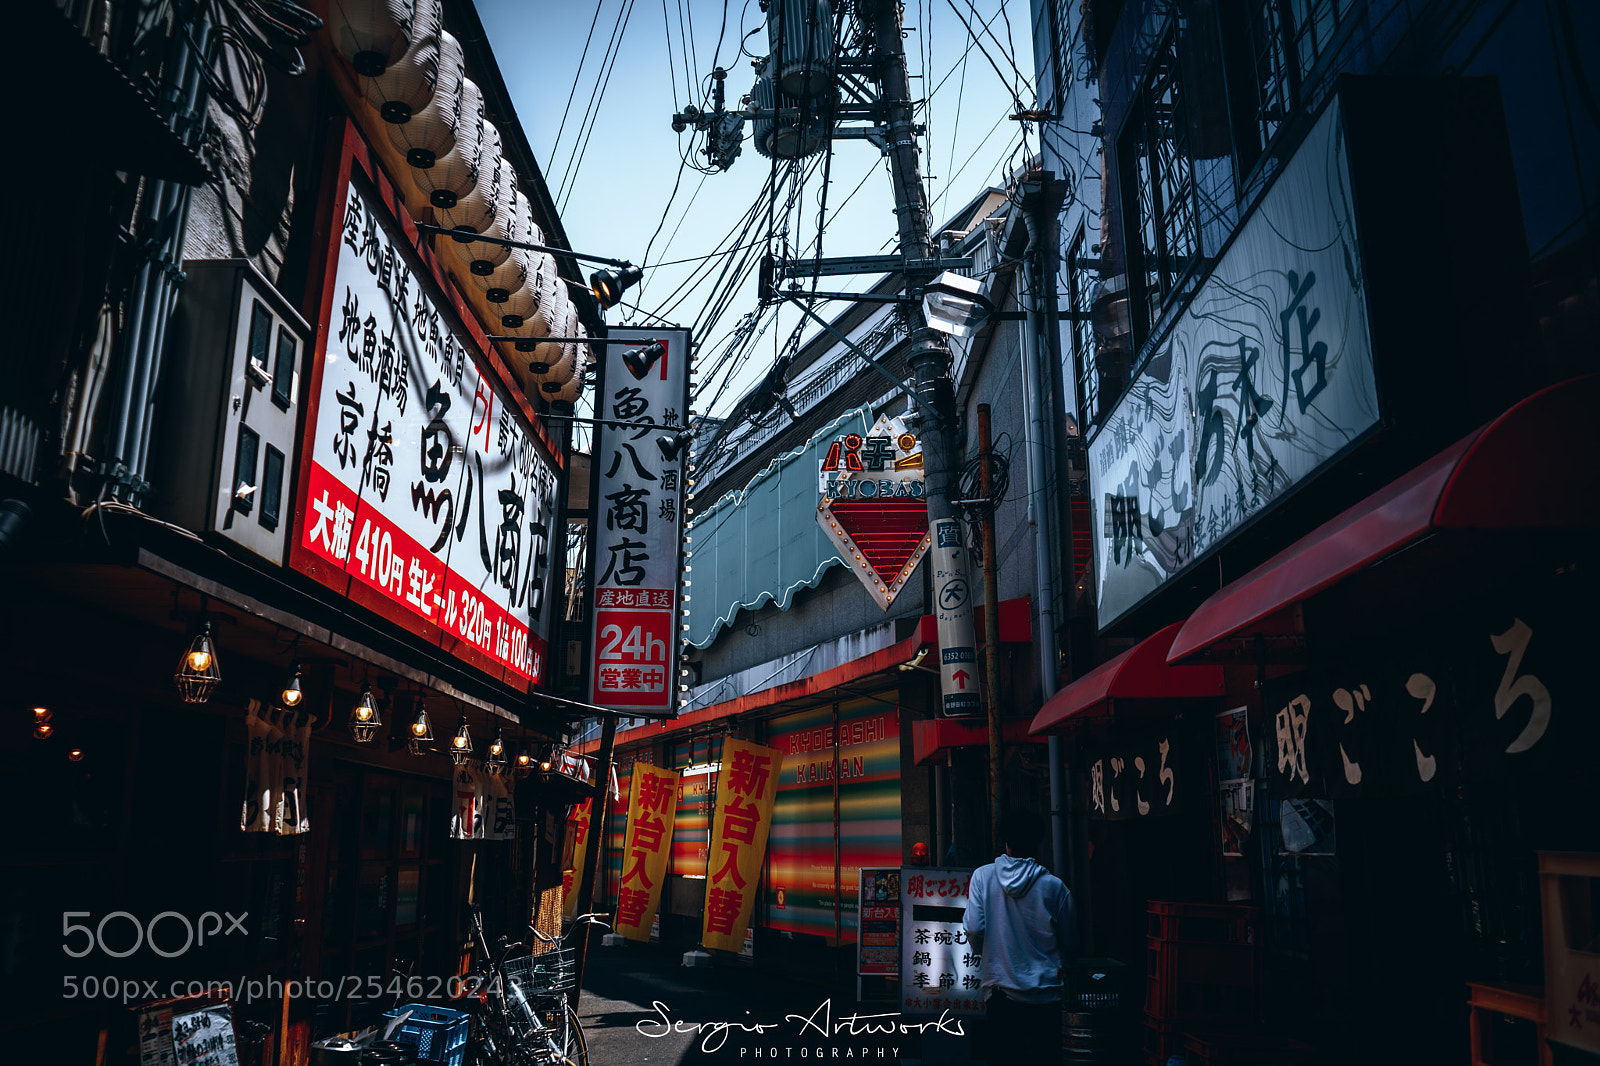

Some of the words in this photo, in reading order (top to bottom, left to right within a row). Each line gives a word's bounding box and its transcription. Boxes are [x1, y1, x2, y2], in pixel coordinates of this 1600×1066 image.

[343, 190, 410, 322] 産地直送
[339, 285, 409, 417] 地魚酒場
[334, 382, 394, 503] 京橋
[658, 407, 680, 524] 地酒場
[1110, 269, 1329, 569] 明ごころ本店
[411, 378, 549, 621] 魚八商店
[597, 386, 658, 586] 魚八商店
[938, 526, 962, 545] 質
[309, 489, 355, 564] 大瓶
[355, 518, 405, 597] 410円
[406, 556, 458, 629] 生ビール
[459, 590, 492, 651] 320円
[598, 589, 671, 608] 産地直送
[599, 624, 666, 662] 24h
[600, 667, 663, 690] 営業中
[1275, 617, 1553, 785] 明ごころ
[789, 717, 885, 756] KYOBASHI
[796, 754, 866, 785] KAIKAN
[1090, 738, 1175, 816] 明ごころ
[617, 771, 676, 929] 新台入替
[706, 748, 771, 936] 新台入替
